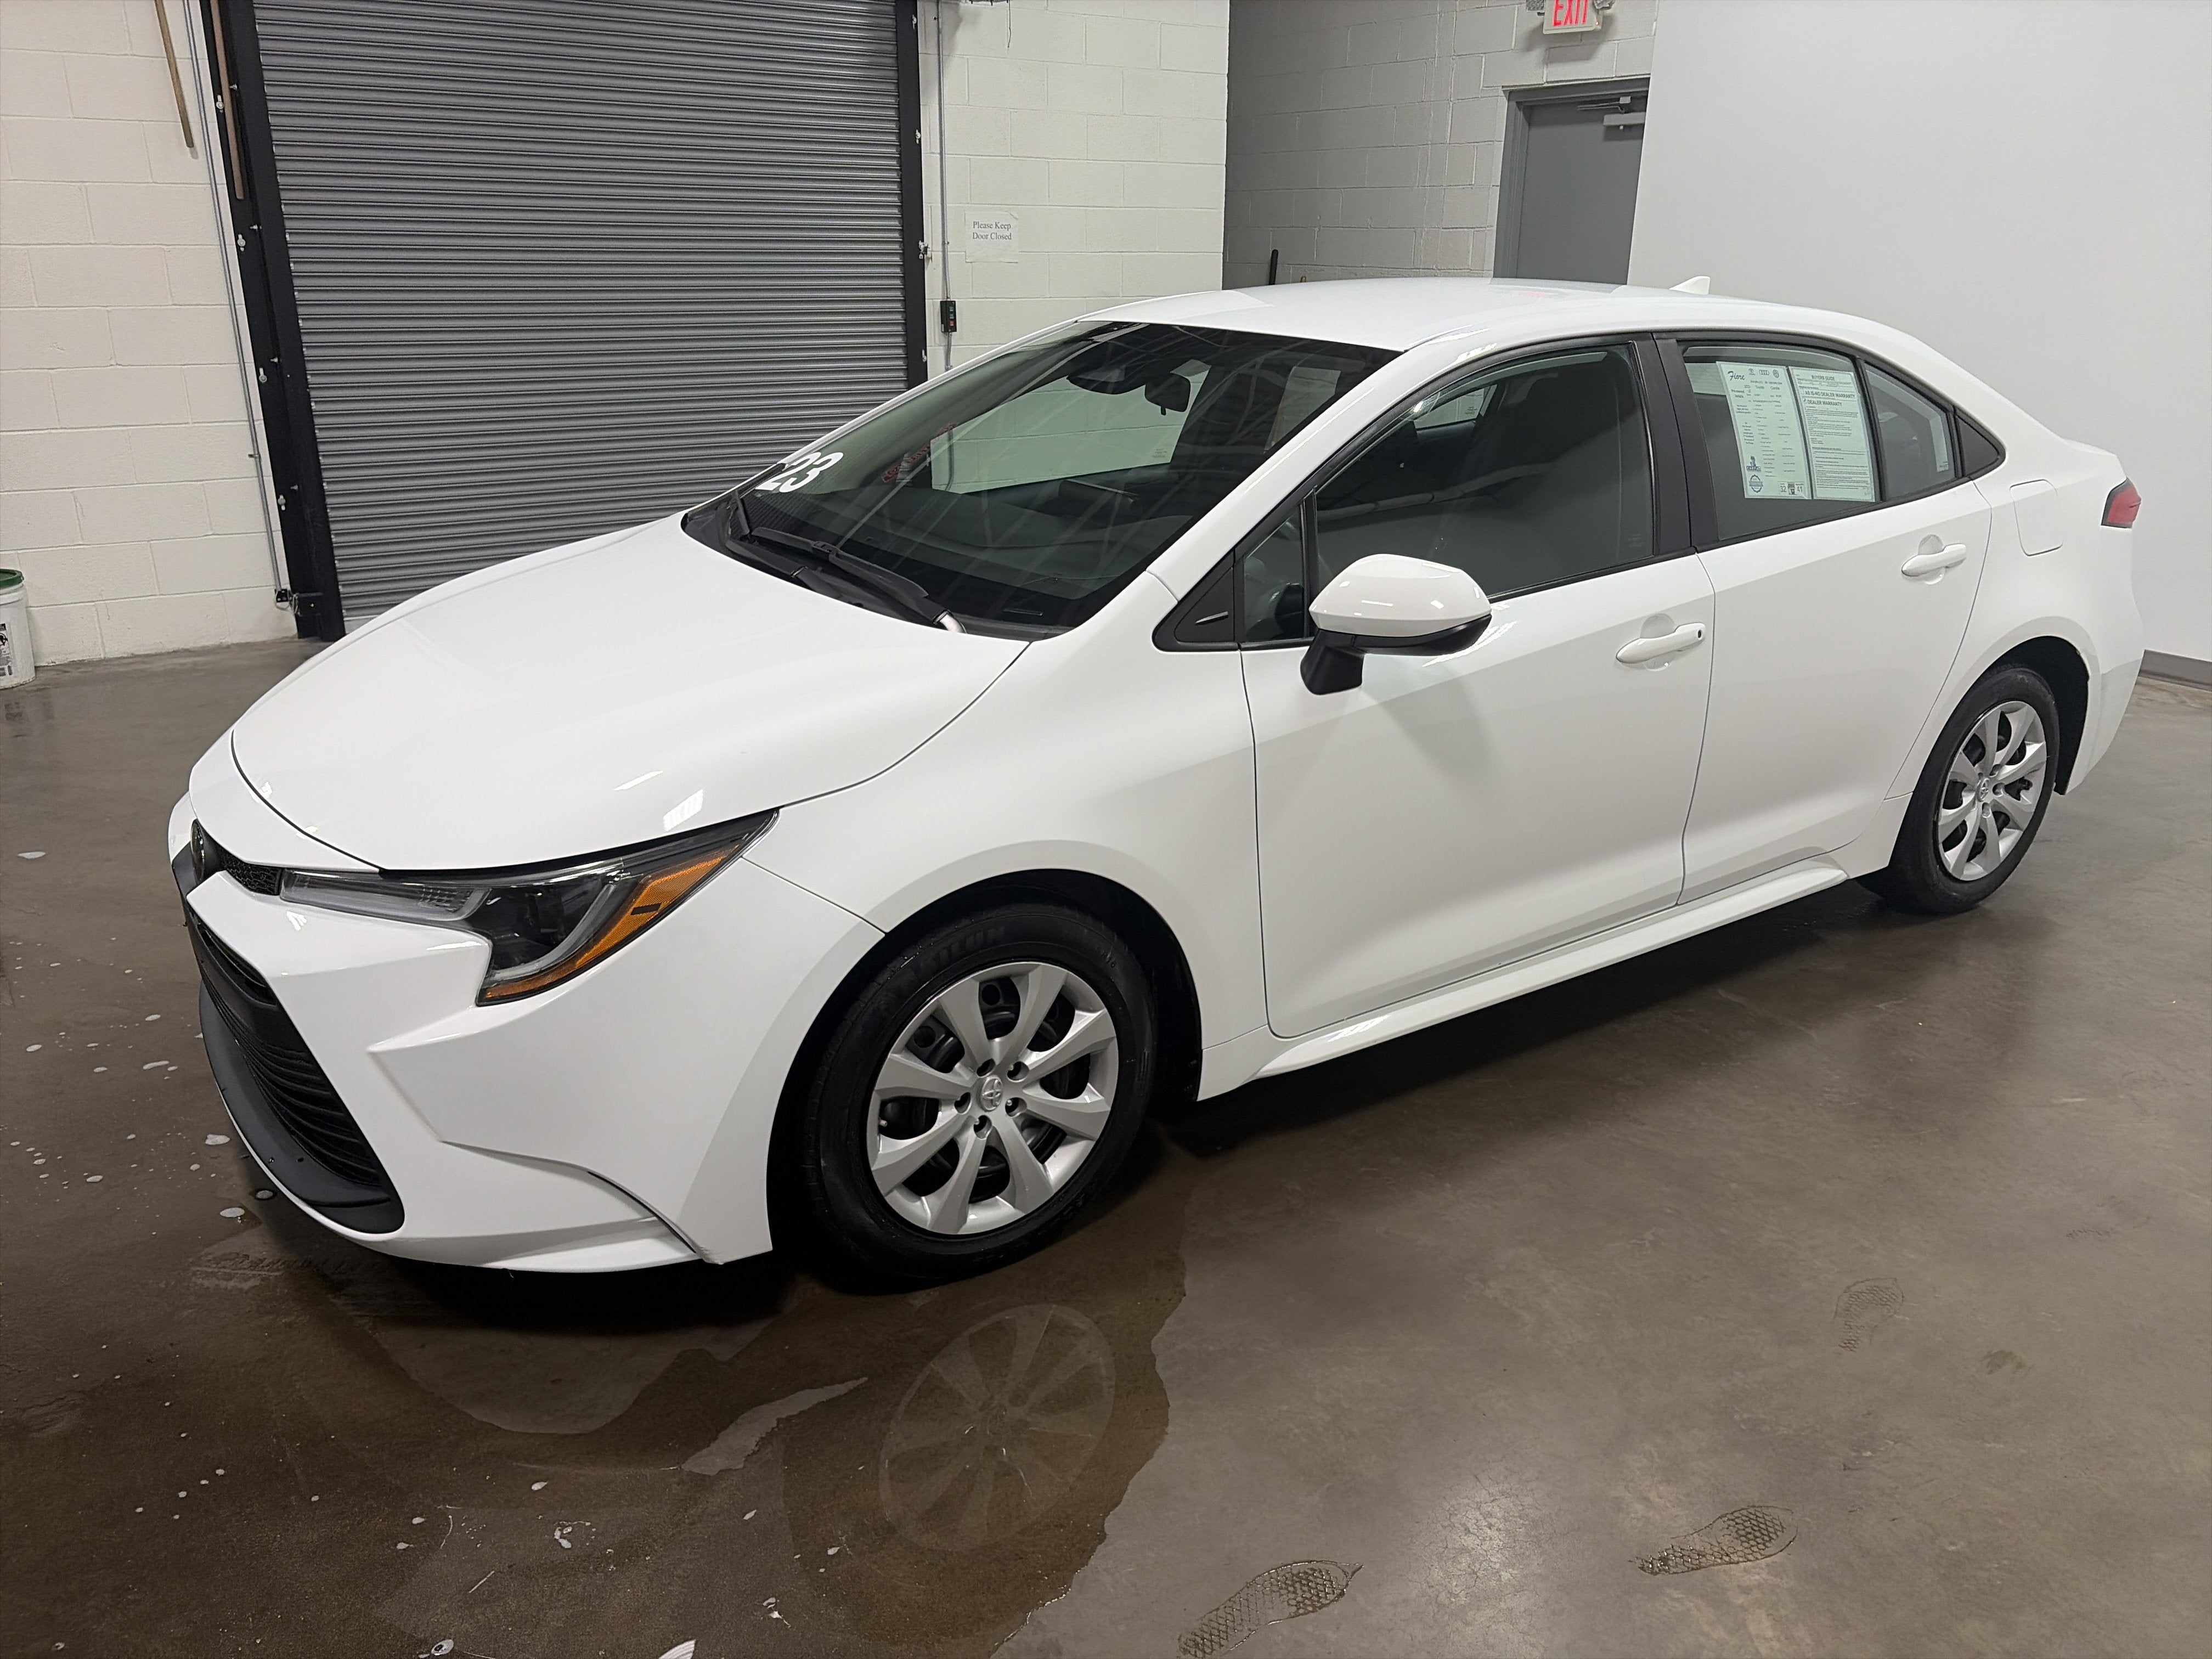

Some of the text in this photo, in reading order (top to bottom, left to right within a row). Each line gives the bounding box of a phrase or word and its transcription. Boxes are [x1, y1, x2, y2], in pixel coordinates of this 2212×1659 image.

[1553, 0, 1588, 26] EXIT
[995, 222, 1011, 231] Keep
[1728, 371, 1745, 381] Fiore
[755, 452, 844, 493] 23
